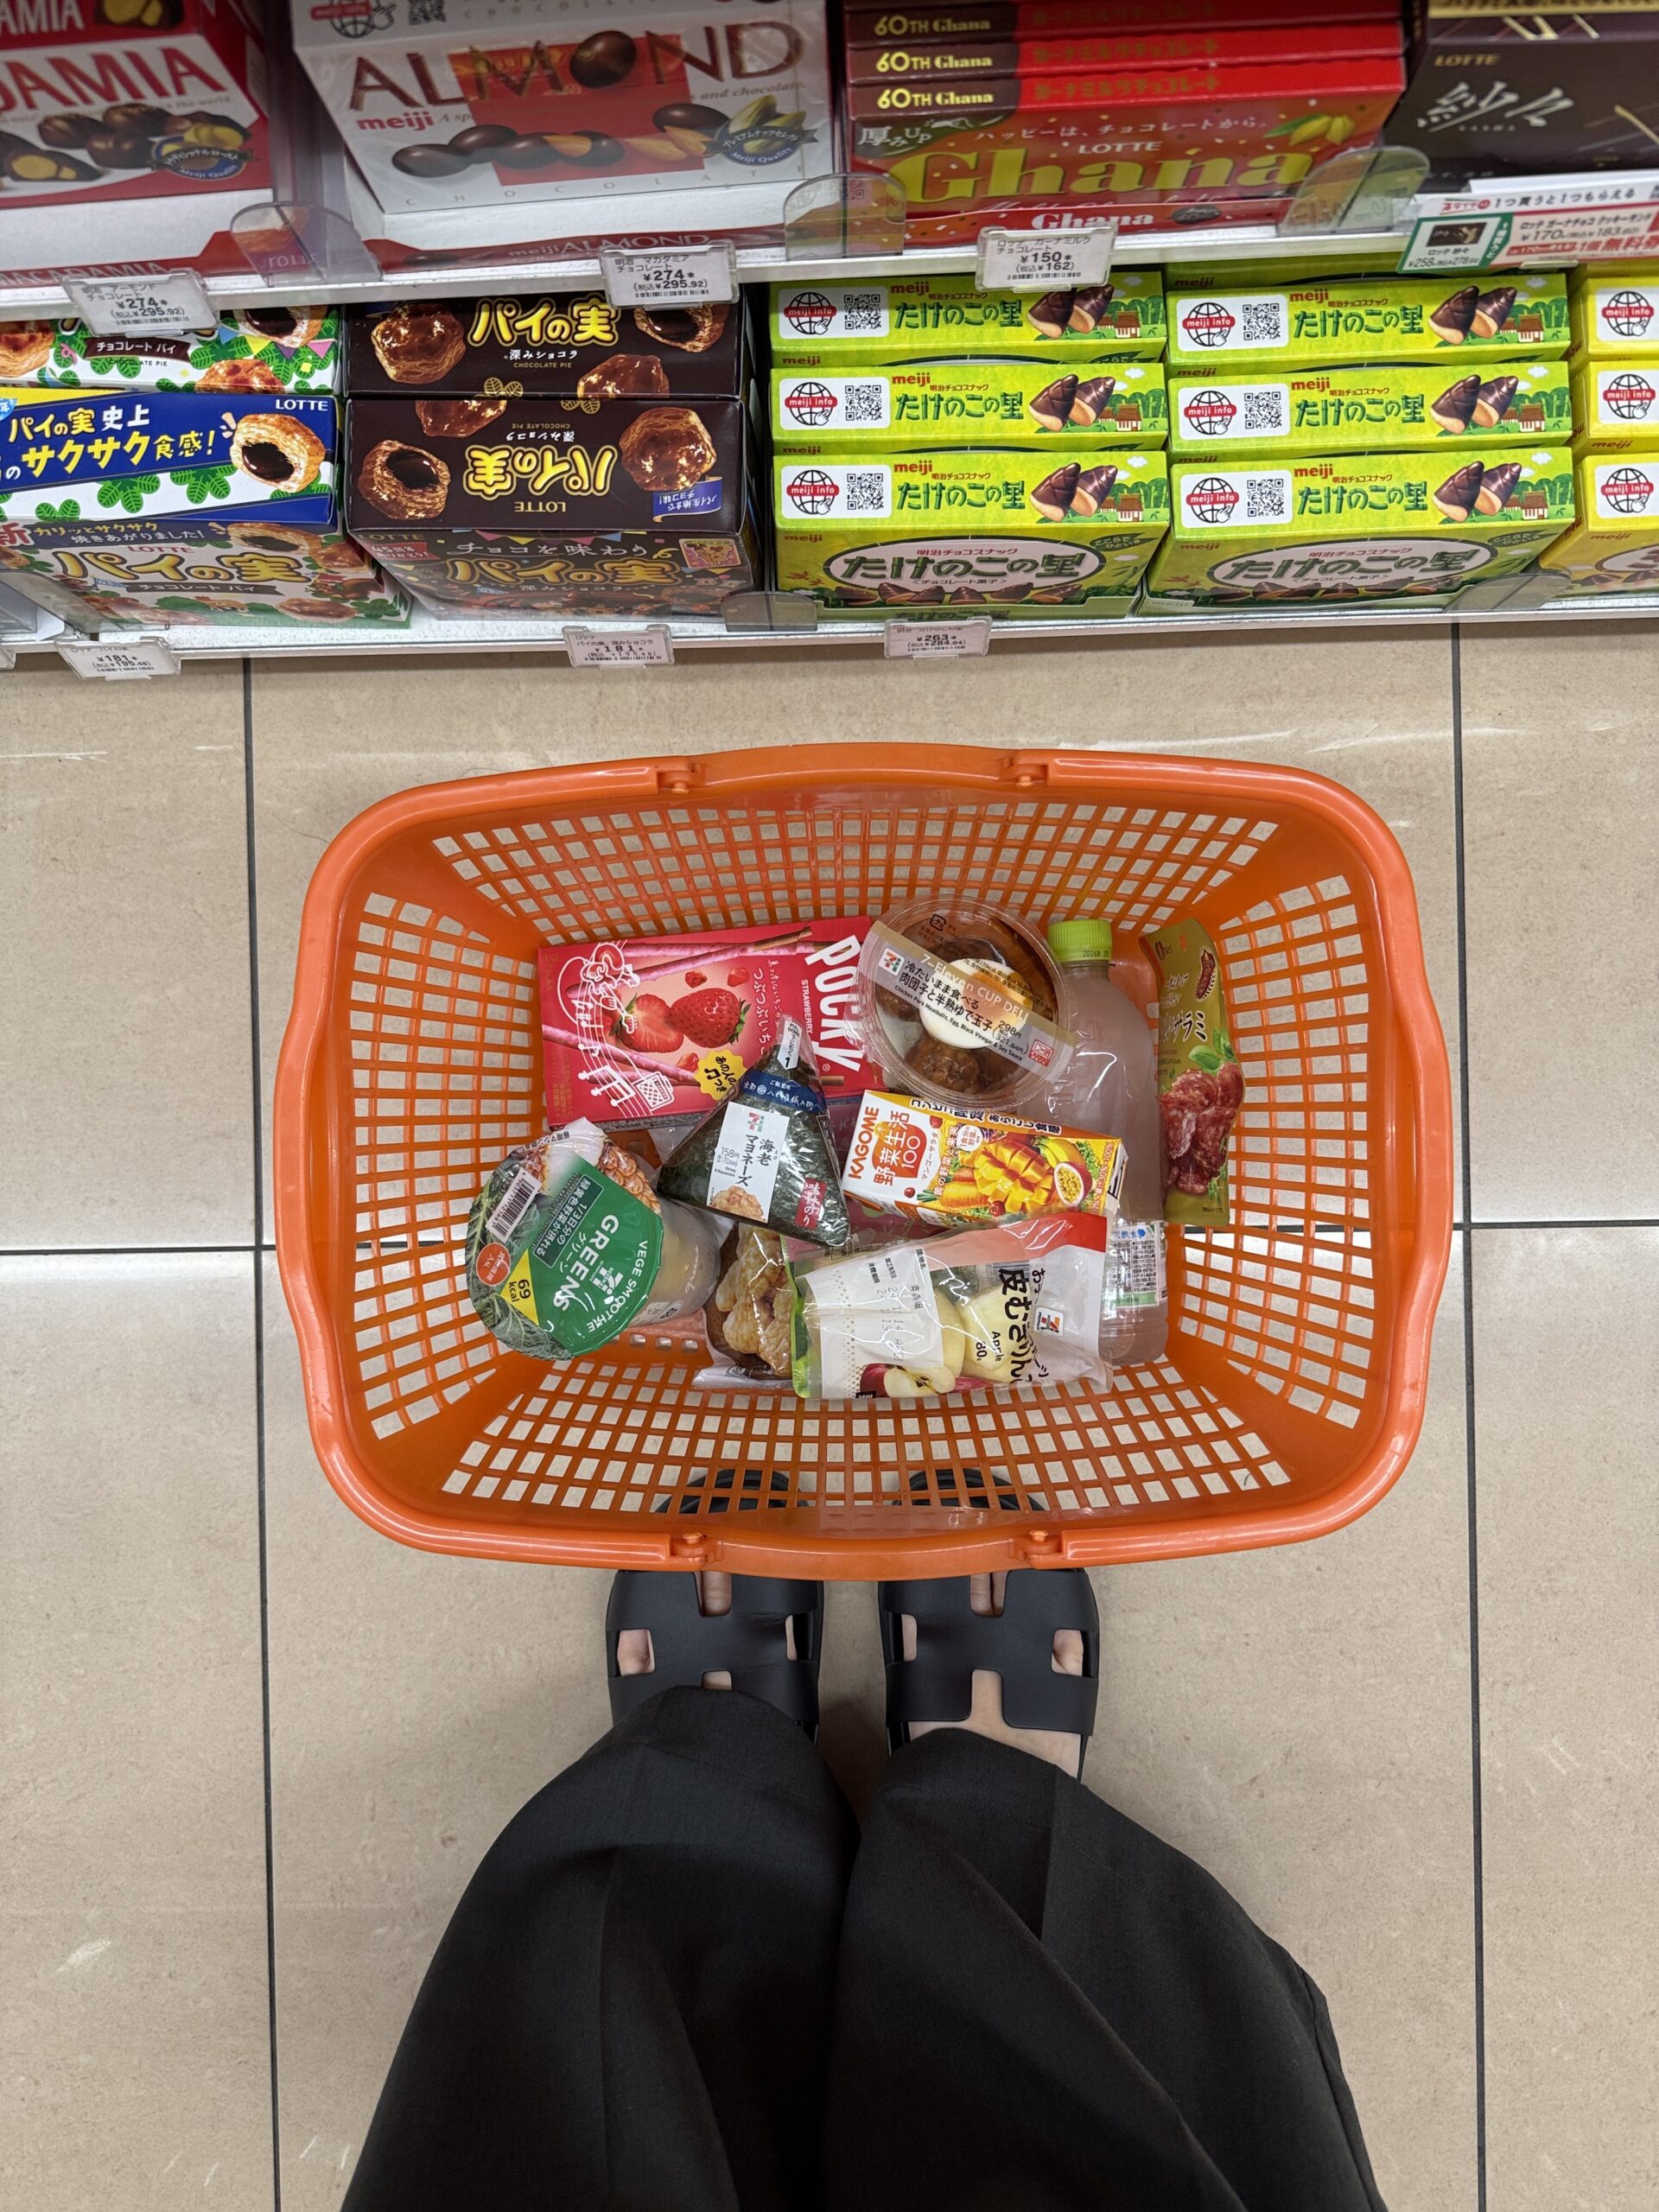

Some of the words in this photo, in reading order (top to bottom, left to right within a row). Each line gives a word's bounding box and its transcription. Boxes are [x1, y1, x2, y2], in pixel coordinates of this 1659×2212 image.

[874, 15, 930, 36] 60TH
[931, 17, 991, 33] Ghana
[875, 51, 931, 73] 60TH
[934, 54, 994, 70] Ghana
[1434, 54, 1501, 67] LOTTE
[0, 47, 228, 111] AMIA
[699, 88, 729, 100] and
[876, 87, 932, 110] 60TH
[935, 91, 995, 106] Ghana
[356, 111, 435, 131] meiji
[1078, 140, 1163, 155] LOTTE
[731, 150, 757, 165] Meiji
[757, 146, 794, 165] Quality
[887, 152, 1314, 204] Ghana
[996, 238, 1026, 248] ロッテ
[1034, 236, 1091, 247] ガーナミルク
[508, 244, 562, 257] meiji
[996, 245, 1053, 255] チョコレート
[642, 255, 690, 264] マカダミア
[616, 264, 673, 273] チョコレート
[109, 283, 157, 292] アーモンド
[890, 283, 931, 296] meiji
[86, 291, 143, 302] チョコレート
[928, 292, 988, 301] 明治チョコスナック
[1289, 289, 1329, 303] meiji
[1327, 297, 1389, 308] 明治チョコスナック
[785, 308, 813, 318] meiji
[812, 308, 833, 317] info
[894, 299, 1023, 330] たけのこの里
[1605, 307, 1630, 318] meiji
[1631, 307, 1650, 316] info
[467, 296, 619, 347] パイの実
[1186, 318, 1210, 328] meiji
[1212, 318, 1230, 327] info
[1293, 304, 1423, 339] たけのこの里
[96, 341, 154, 353] チョコレート
[507, 348, 579, 361] 深みショコラ
[782, 355, 822, 365] meiji
[892, 372, 931, 385] meiji
[1177, 367, 1217, 378] meiji
[929, 384, 989, 392] 明治チョコスナック
[1290, 378, 1331, 391] meiji
[1329, 386, 1390, 397] 明治チョコスナック
[788, 397, 815, 408] meiji
[813, 397, 835, 407] info
[1606, 390, 1631, 401] meiji
[1632, 390, 1652, 399] info
[275, 398, 329, 411] LOTTE
[895, 390, 1024, 421] たけのこの里
[1295, 393, 1425, 428] たけのこの里
[1188, 407, 1211, 417] meiji
[1214, 407, 1232, 416] info
[505, 430, 575, 442] 深みショコラ
[1592, 440, 1632, 449] meiji
[0, 429, 216, 481] のサクサク食感!
[463, 444, 617, 496] パイの実
[893, 461, 933, 474] meiji
[1294, 463, 1334, 478] meiji
[931, 471, 991, 480] 明治チョコスナック
[1332, 473, 1394, 484] 明治チョコスナック
[790, 486, 817, 497] meiji
[816, 486, 836, 495] info
[1605, 483, 1629, 493] meiji
[1630, 483, 1649, 493] info
[658, 489, 696, 505] チョコ味!
[896, 480, 1026, 511] たけのこの里
[1190, 495, 1213, 505] meiji
[1216, 493, 1235, 503] info
[1297, 480, 1428, 516] たけのこの里
[514, 500, 567, 513] LOTTE
[666, 494, 718, 512] パイ生地まで
[357, 532, 425, 542] LOTTE
[784, 534, 823, 543] meiji
[128, 543, 196, 554] LOTTE
[445, 543, 649, 557] チョコを味わう
[916, 547, 1019, 557] 明治チョコスナック
[1180, 542, 1220, 551] meiji
[1308, 547, 1414, 558] 明治チョコスナック
[52, 550, 313, 583] パイの実
[445, 557, 682, 587] パイの実
[841, 551, 1087, 581] たけのこの里
[1227, 550, 1482, 581] たけのこの里
[904, 960, 980, 1010] 冷たいまま食べる
[800, 978, 814, 1035] STRAWBERRY
[899, 971, 994, 1033] 肉団子と半熟ゆで玉子
[976, 986, 1001, 1006] CUP
[1002, 1000, 1029, 1020] DELI
[894, 985, 912, 998] Chicken
[912, 995, 925, 1006] Pork
[925, 1002, 949, 1020] Meatballs,
[949, 1017, 961, 1029] Egg,
[961, 1021, 975, 1034] Black
[975, 1029, 994, 1045] Vinegar
[999, 1044, 1009, 1054] Soy
[1008, 1048, 1023, 1061] Sauce
[998, 1020, 1023, 1039] 298円
[785, 1056, 792, 1069] 1
[715, 1080, 728, 1093] つき
[848, 1105, 880, 1180] KAGOME
[874, 1110, 910, 1187] 野菜生活
[720, 1146, 741, 1160] 158円
[756, 1137, 776, 1166] 海老
[900, 1135, 922, 1169] 100
[921, 1132, 938, 1181] マンゴーサラダ
[734, 1134, 760, 1187] マヨネーズ
[933, 1123, 963, 1197] 黄の野菜と果実
[536, 1177, 592, 1257] 緑黄色野菜が摂れる
[556, 1203, 588, 1246] 1/3日分の
[559, 1230, 588, 1274] グリーン
[632, 1239, 648, 1278] VEGE
[552, 1214, 620, 1312] GREENS
[508, 1281, 520, 1303] kcal
[518, 1279, 531, 1300] 69
[587, 1275, 638, 1333] SMOOTHIE
[991, 1331, 1003, 1363] Apple
